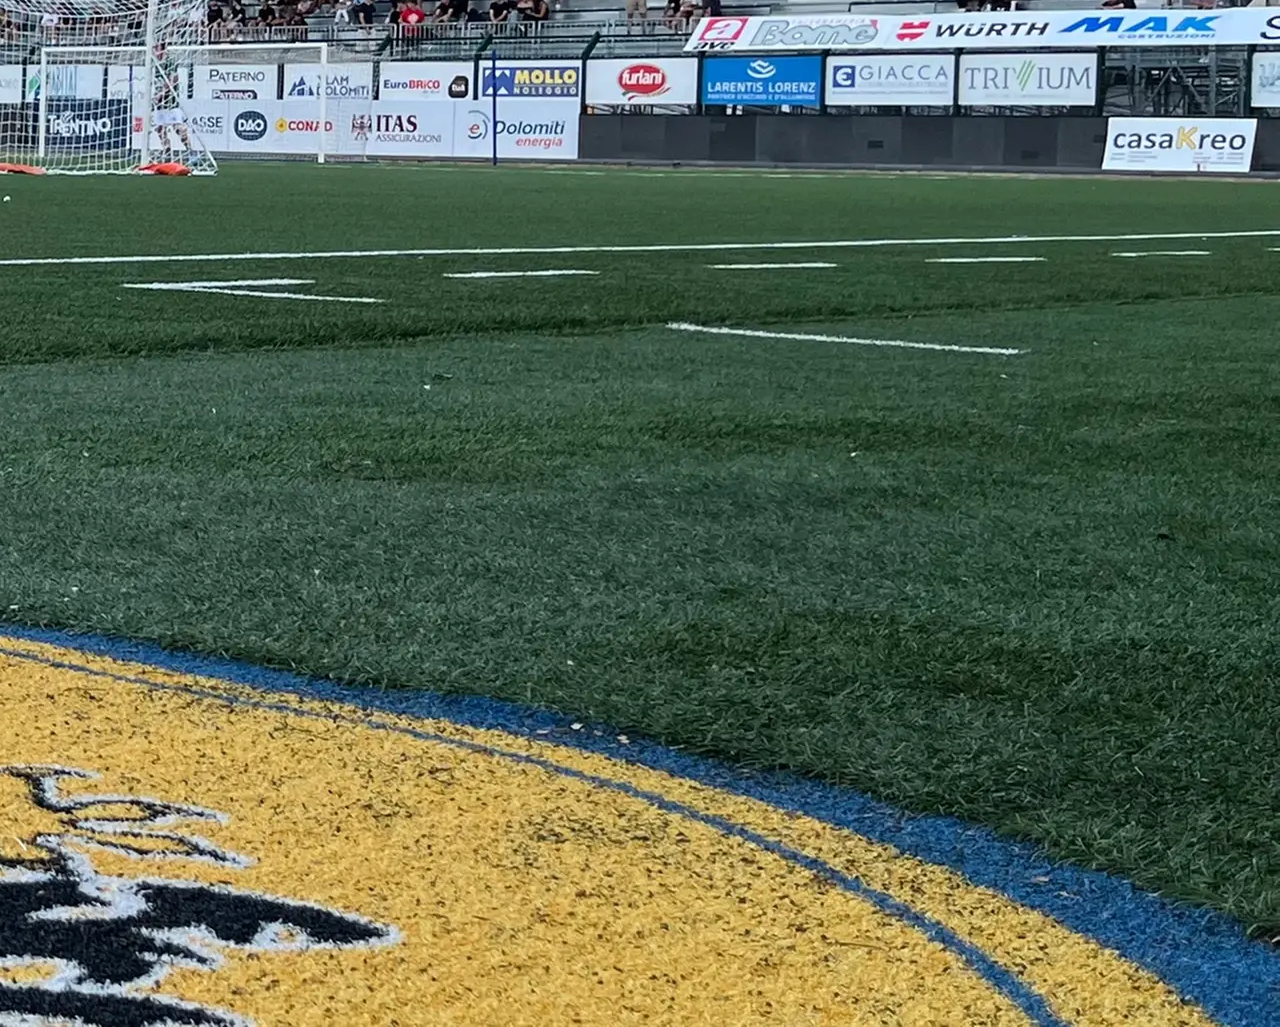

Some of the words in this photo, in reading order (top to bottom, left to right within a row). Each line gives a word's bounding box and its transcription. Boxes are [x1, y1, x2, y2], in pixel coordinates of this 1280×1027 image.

[935, 21, 1050, 39] WÜRTH
[1057, 15, 1222, 34] MAK
[1118, 32, 1216, 40] COSTRUZIONI
[209, 68, 266, 83] PATERNO
[514, 69, 578, 84] MOLLO
[621, 68, 663, 86] furlani
[859, 64, 949, 81] GIACCA
[965, 60, 1092, 91] TRIVIUM
[212, 89, 254, 100] PATERNO
[513, 86, 578, 95] NOLEGGIO
[707, 81, 764, 93] LARENTIS
[769, 81, 816, 93] LORENZ
[47, 112, 111, 137] TRENTINO
[376, 114, 418, 133] ITAS
[494, 120, 566, 136] Dolomiti
[375, 134, 442, 143] ASSICURAZIONI
[515, 136, 563, 149] energia
[1113, 126, 1247, 151] casaKreo
